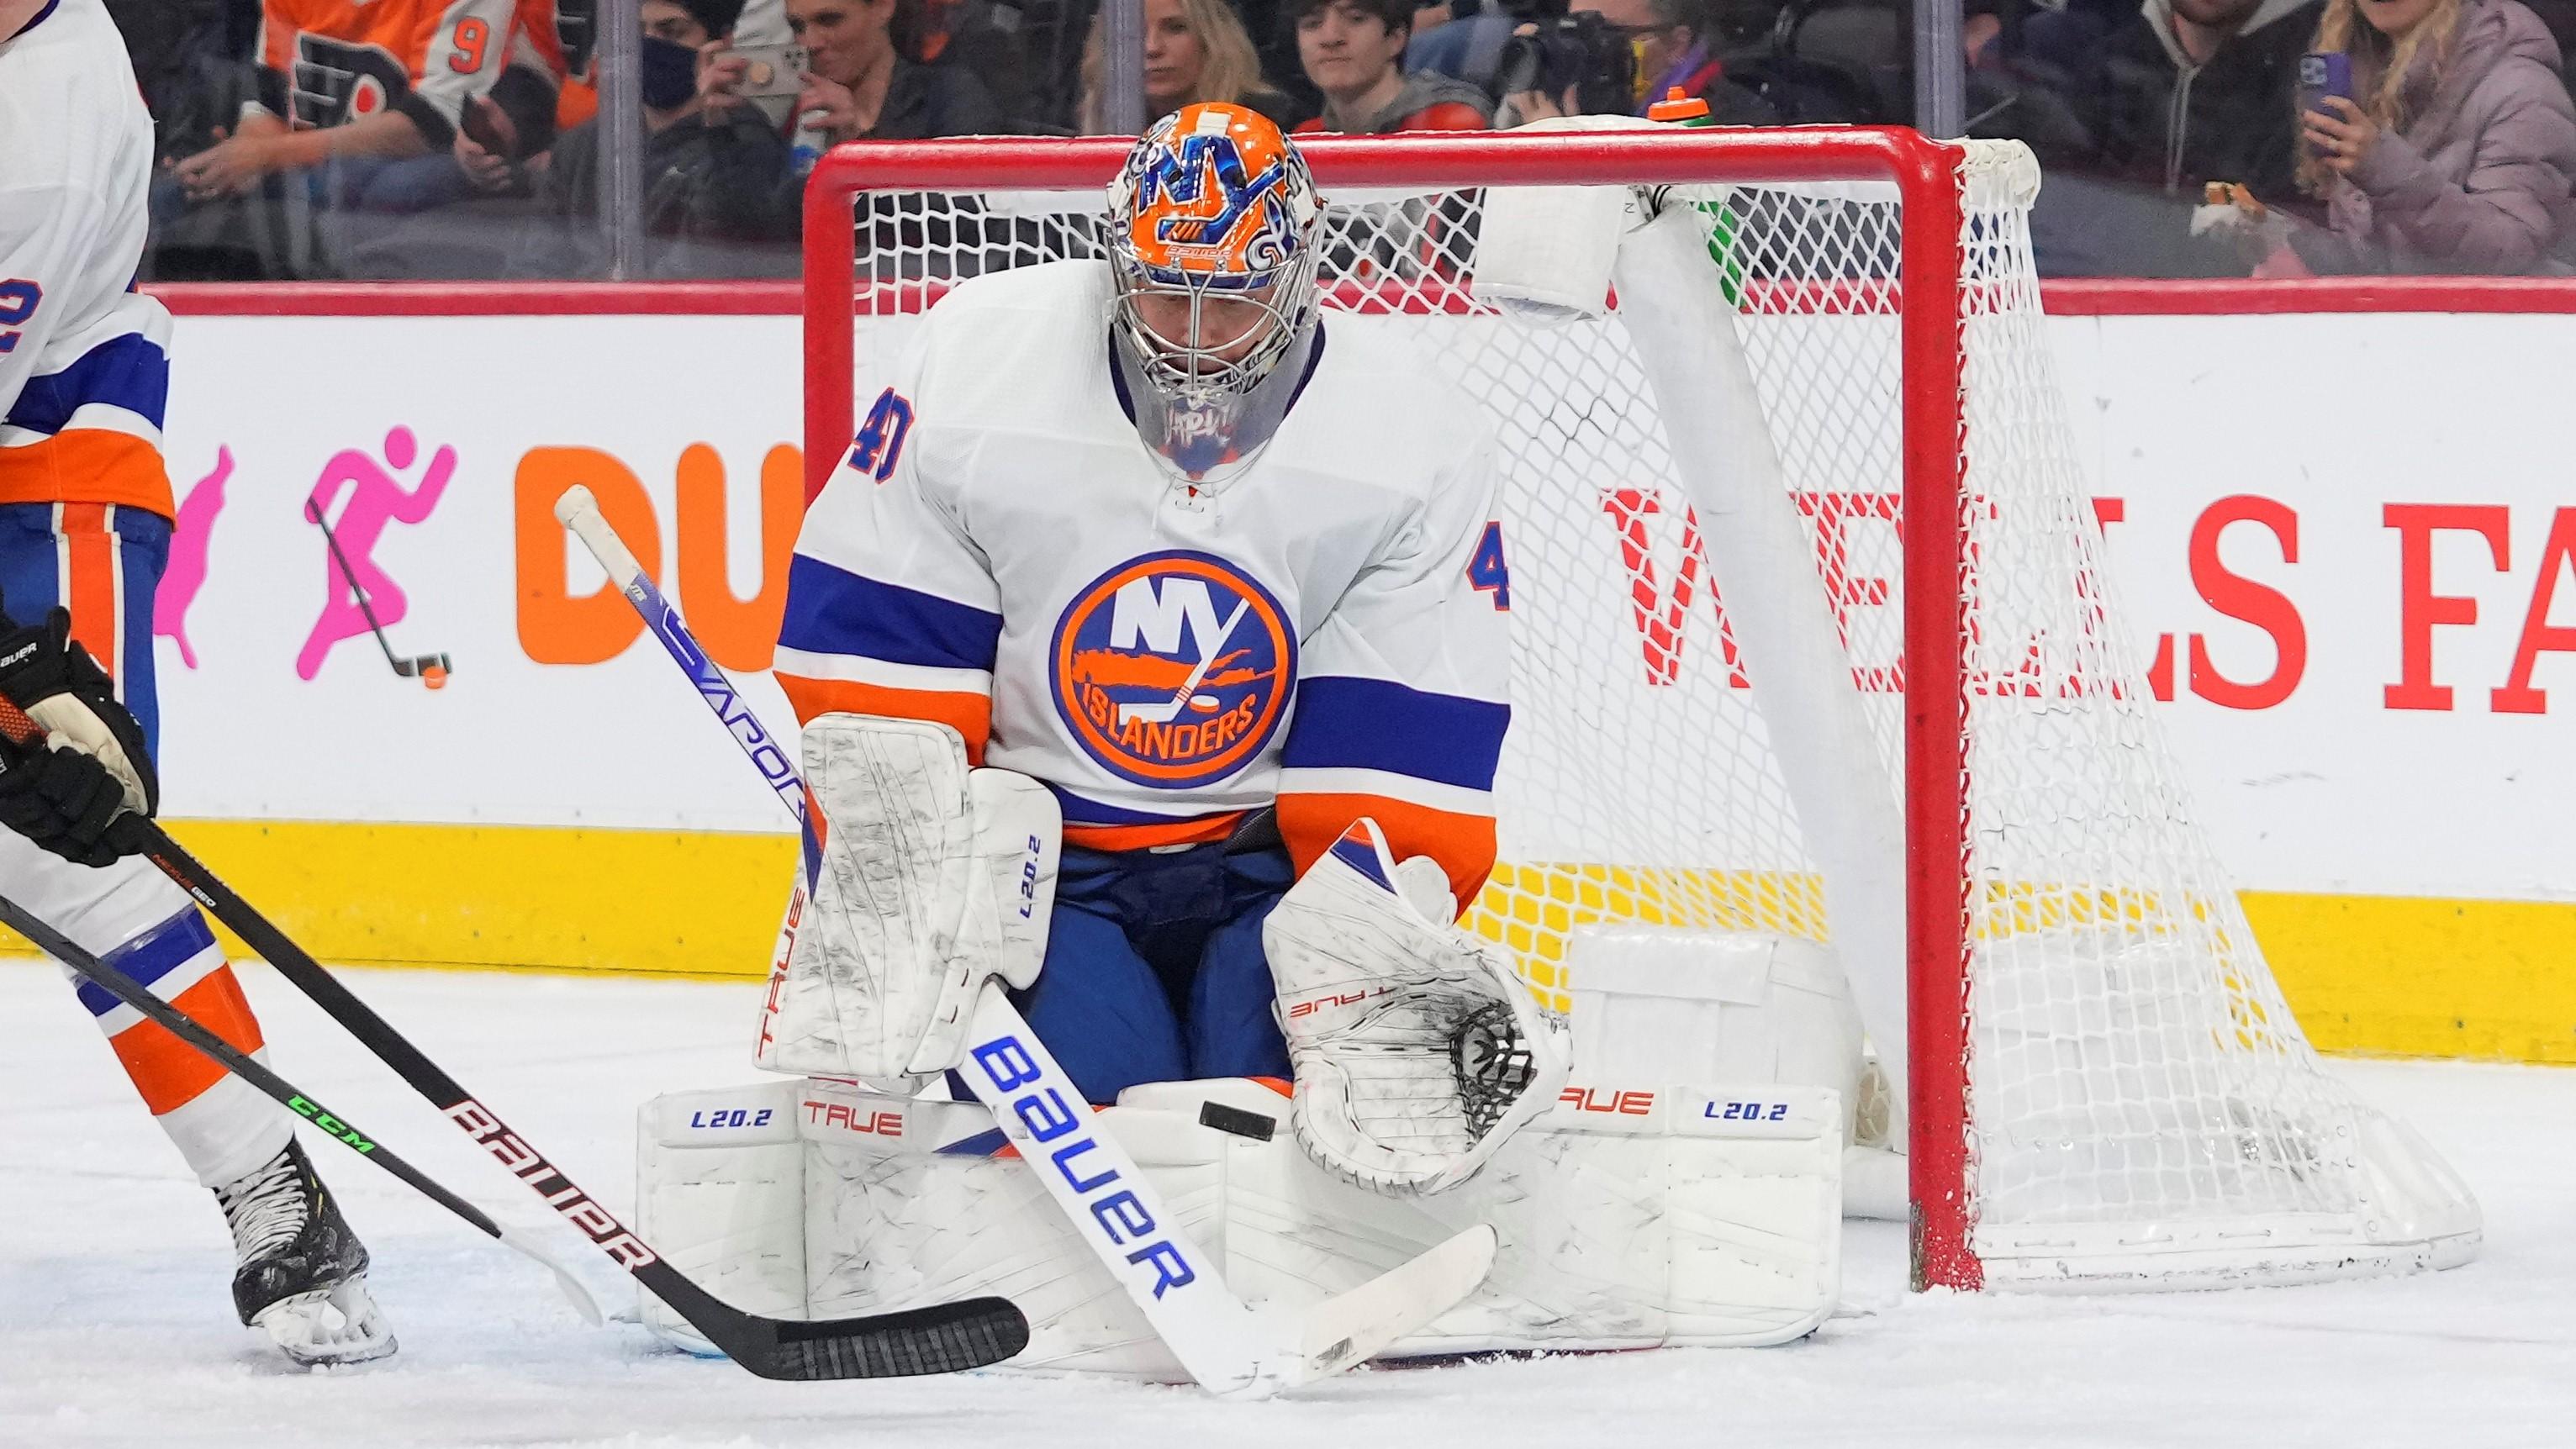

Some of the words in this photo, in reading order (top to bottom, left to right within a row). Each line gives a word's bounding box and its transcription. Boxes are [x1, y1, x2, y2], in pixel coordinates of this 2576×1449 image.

[449, 17, 489, 74] 9
[847, 387, 915, 484] 40
[1465, 521, 1509, 611] 4
[1110, 576, 1251, 704] NY
[1081, 682, 1257, 761] ISLANDERS
[1019, 834, 1042, 919] L20.2
[757, 887, 805, 1060] TRUE
[1290, 986, 1397, 1018] TRUE
[287, 1093, 376, 1154] CCM
[691, 1108, 773, 1129] L20.2
[803, 1101, 903, 1136] TRUE
[1704, 1101, 1787, 1120] L20.2
